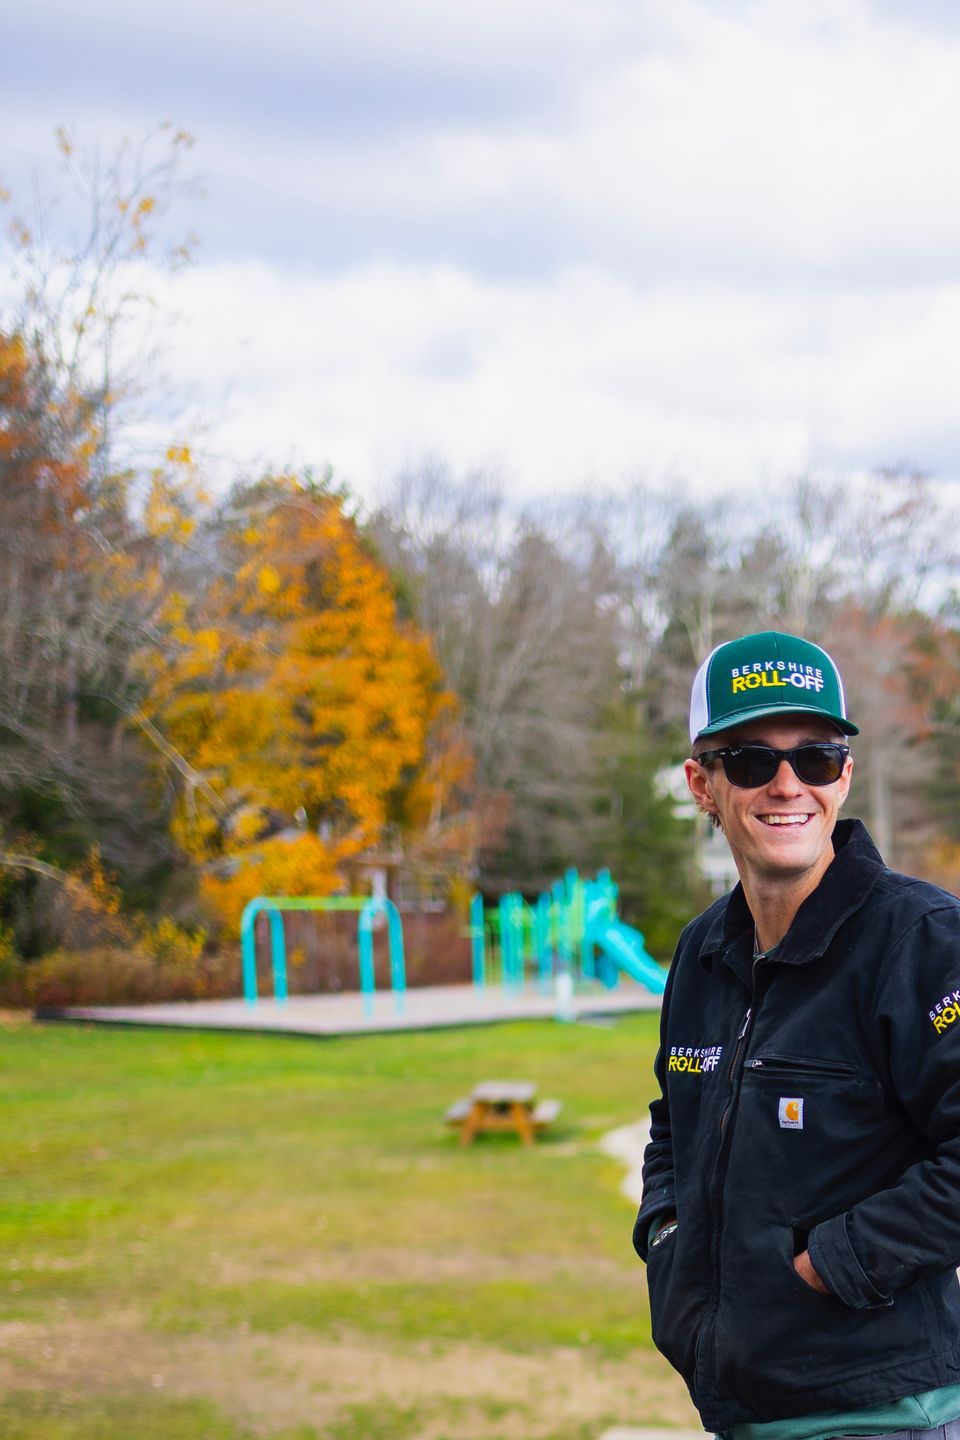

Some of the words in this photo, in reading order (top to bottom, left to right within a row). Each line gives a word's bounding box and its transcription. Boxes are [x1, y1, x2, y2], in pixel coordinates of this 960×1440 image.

[731, 661, 823, 679] BERKSHIRE
[732, 670, 824, 694] ROLL-OFF
[670, 1046, 723, 1058] BERKSHIRE
